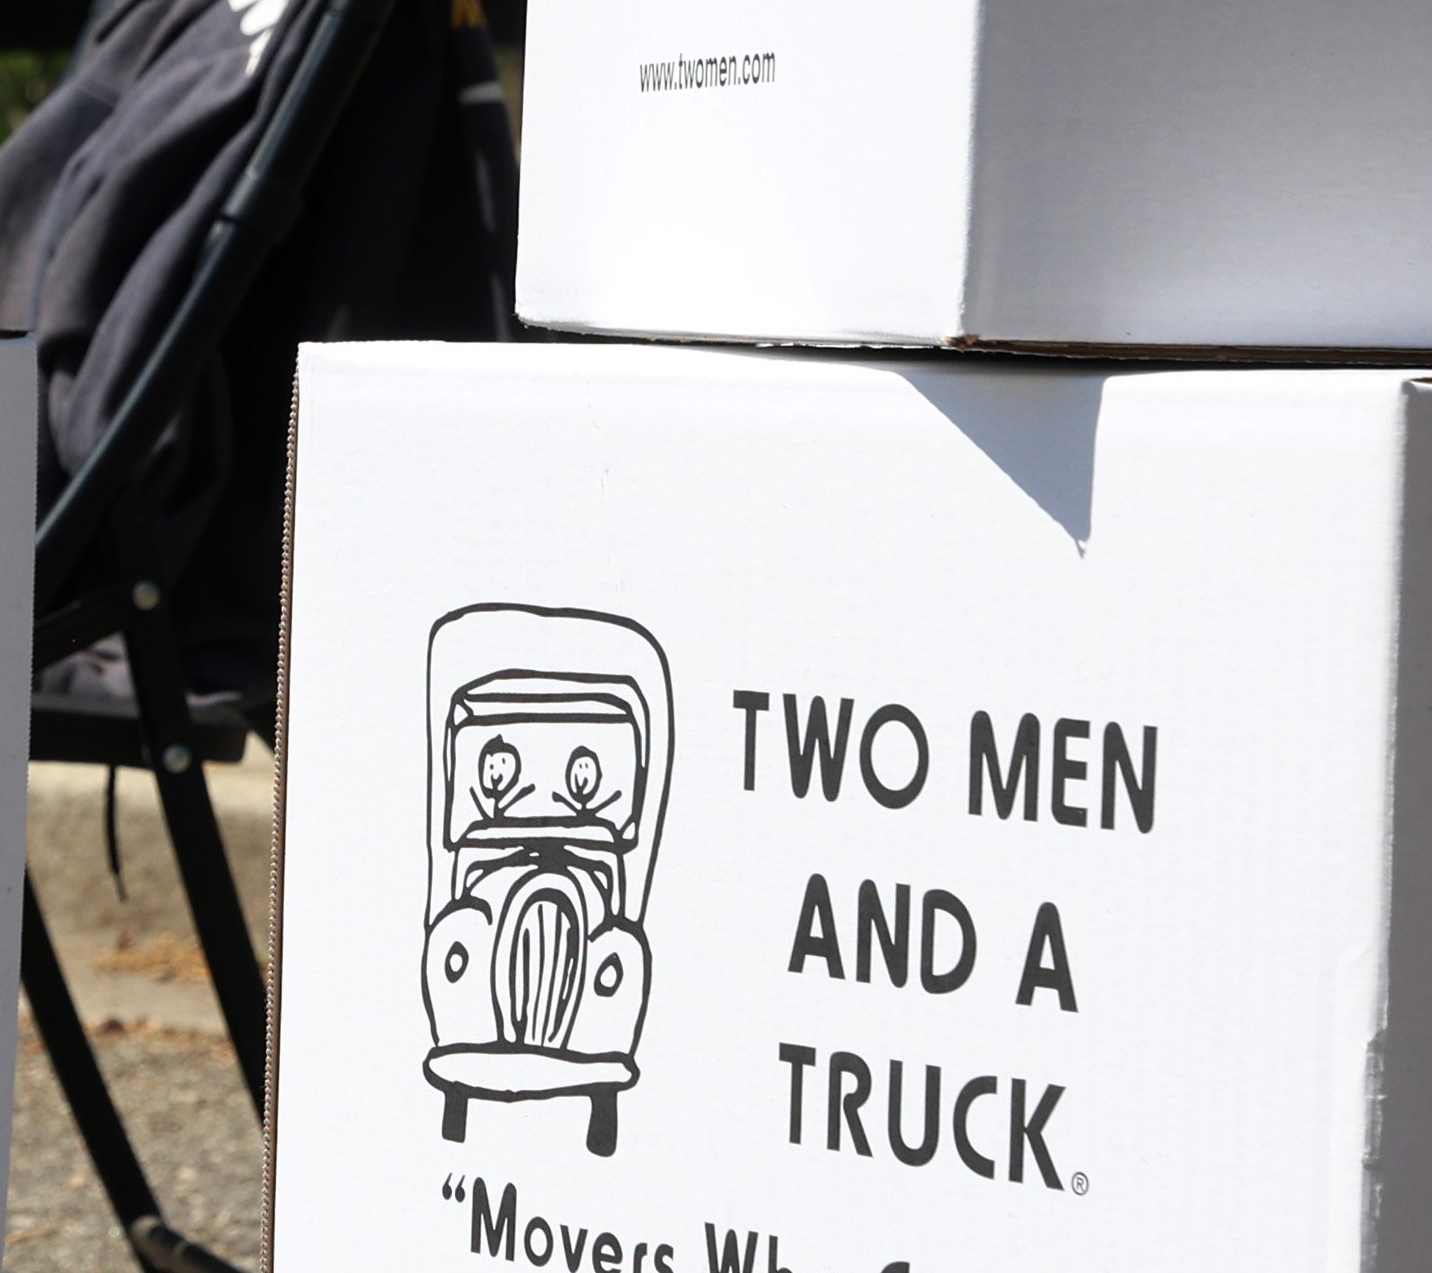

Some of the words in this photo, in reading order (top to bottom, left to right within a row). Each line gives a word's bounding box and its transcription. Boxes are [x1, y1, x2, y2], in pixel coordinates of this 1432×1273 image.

[640, 52, 775, 92] www.twomen.com
[733, 690, 929, 809] TWO
[969, 710, 1158, 834] MEN
[788, 873, 977, 994] AND
[1015, 902, 1078, 1013] A
